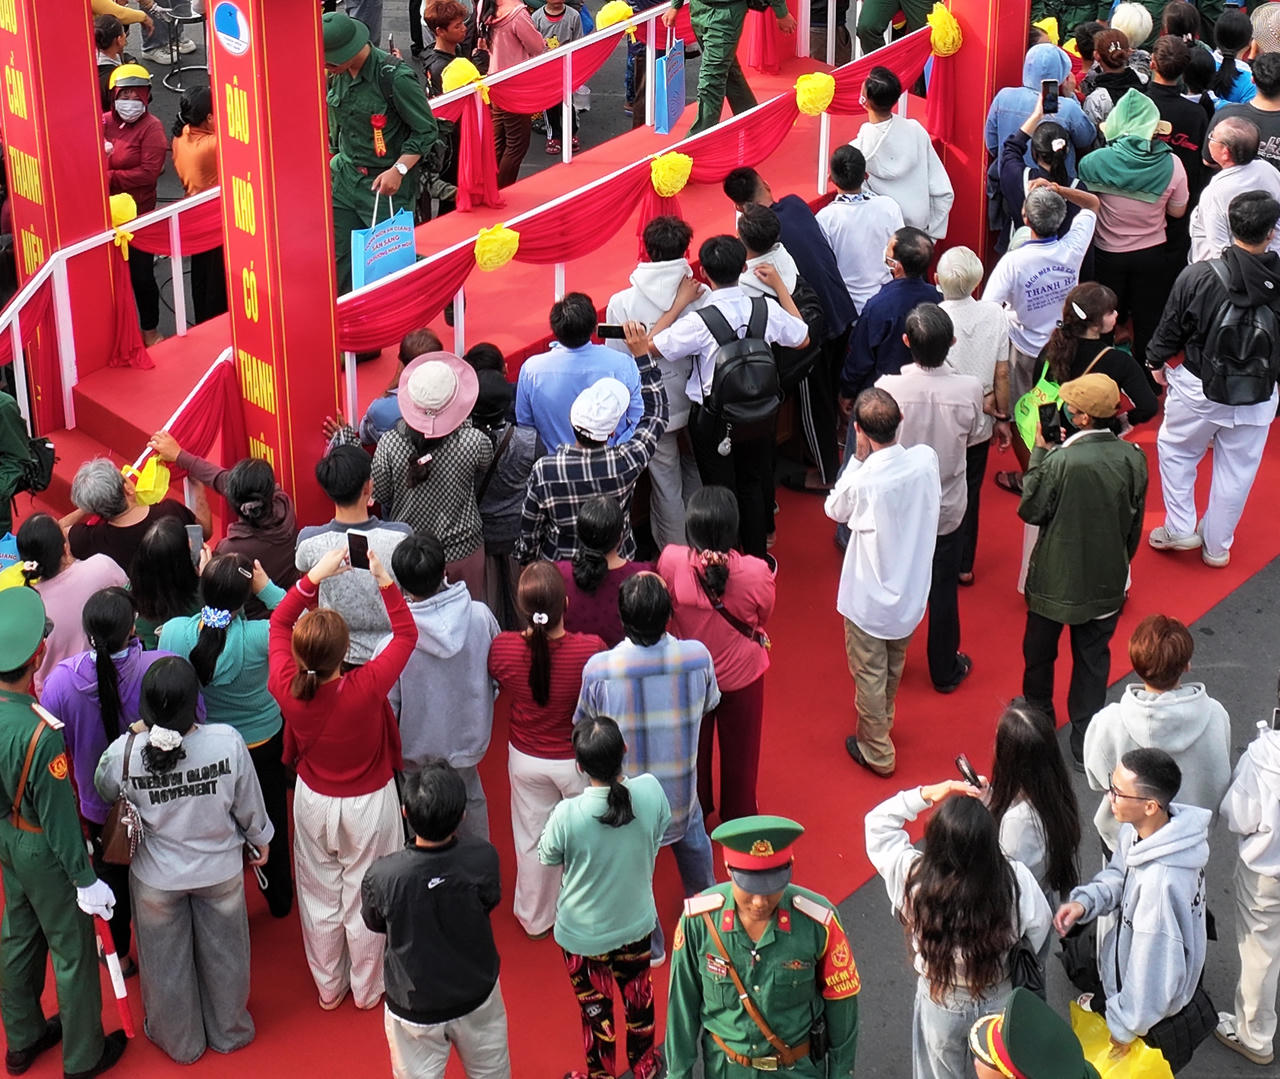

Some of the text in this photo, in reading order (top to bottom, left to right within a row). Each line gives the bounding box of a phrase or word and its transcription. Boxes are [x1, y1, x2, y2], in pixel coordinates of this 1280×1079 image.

[5, 50, 28, 121] CẦN
[225, 75, 250, 145] ĐÂU
[8, 144, 43, 206] THANH
[232, 171, 256, 237] KHÓ
[21, 223, 45, 277] NIÊN
[242, 260, 259, 324] CÓ
[1025, 281, 1061, 298] THANH
[238, 348, 276, 416] THANH
[148, 780, 218, 805] MOVEMENT
[186, 757, 232, 783] GLOBAL
[825, 970, 850, 987] KIỂM
